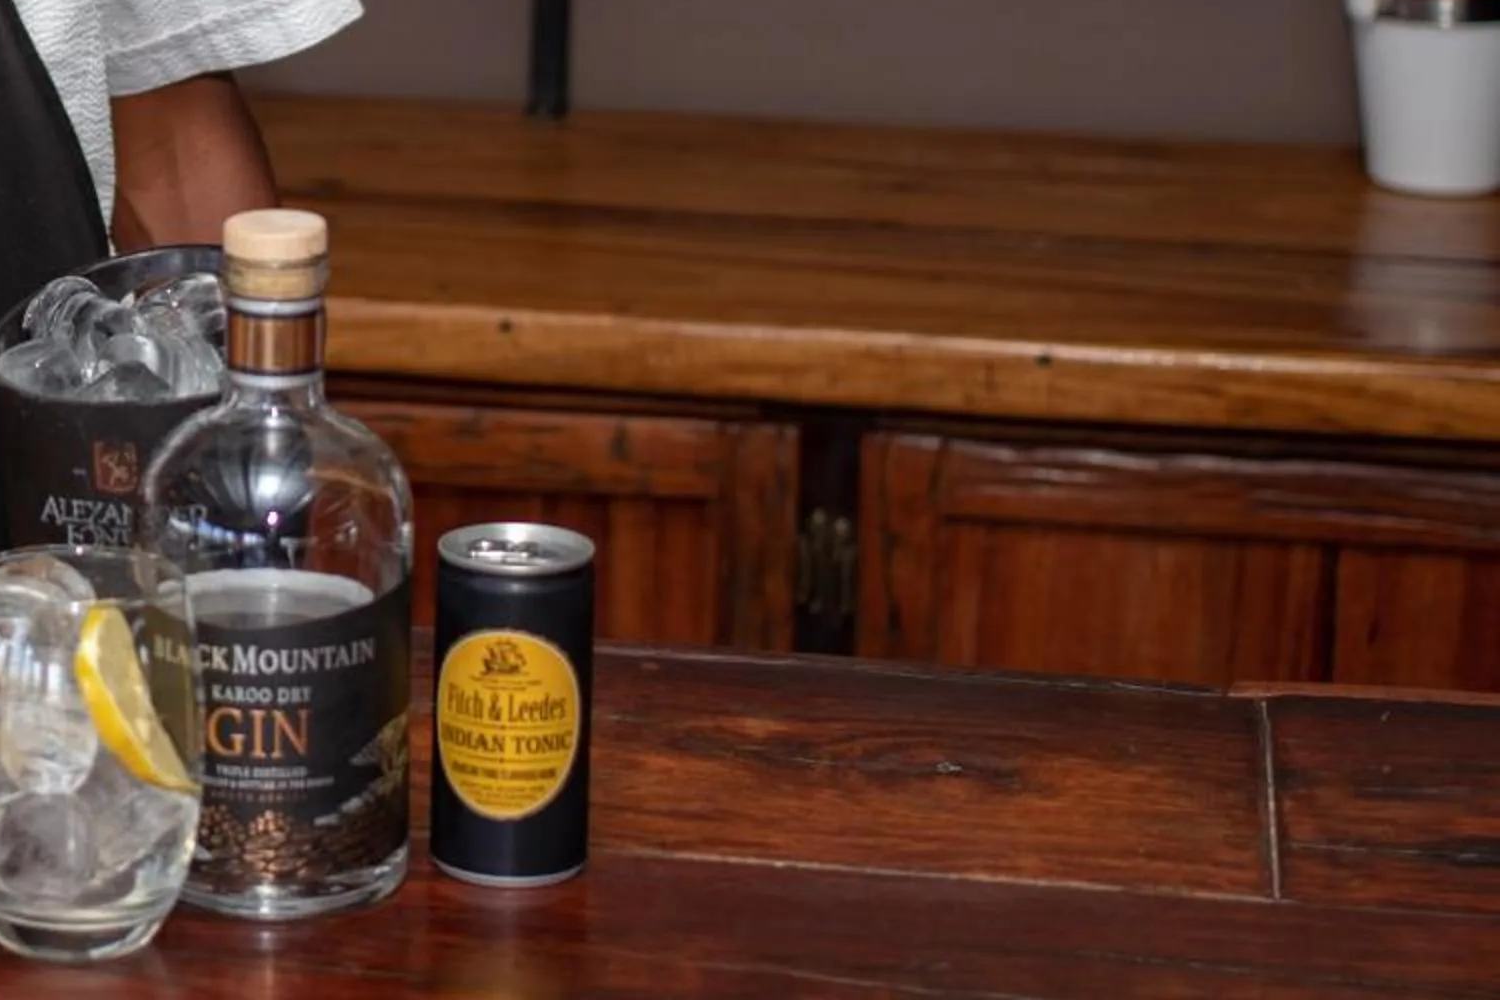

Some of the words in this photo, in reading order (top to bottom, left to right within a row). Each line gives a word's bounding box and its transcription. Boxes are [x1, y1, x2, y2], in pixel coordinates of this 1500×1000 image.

[231, 636, 376, 676] MOUNTAIN
[211, 683, 273, 704] KAROO
[447, 682, 484, 719] Fitch
[489, 692, 502, 721] &
[508, 692, 566, 722] Leedes
[206, 707, 311, 759] GIN
[514, 730, 573, 755] TONIC
